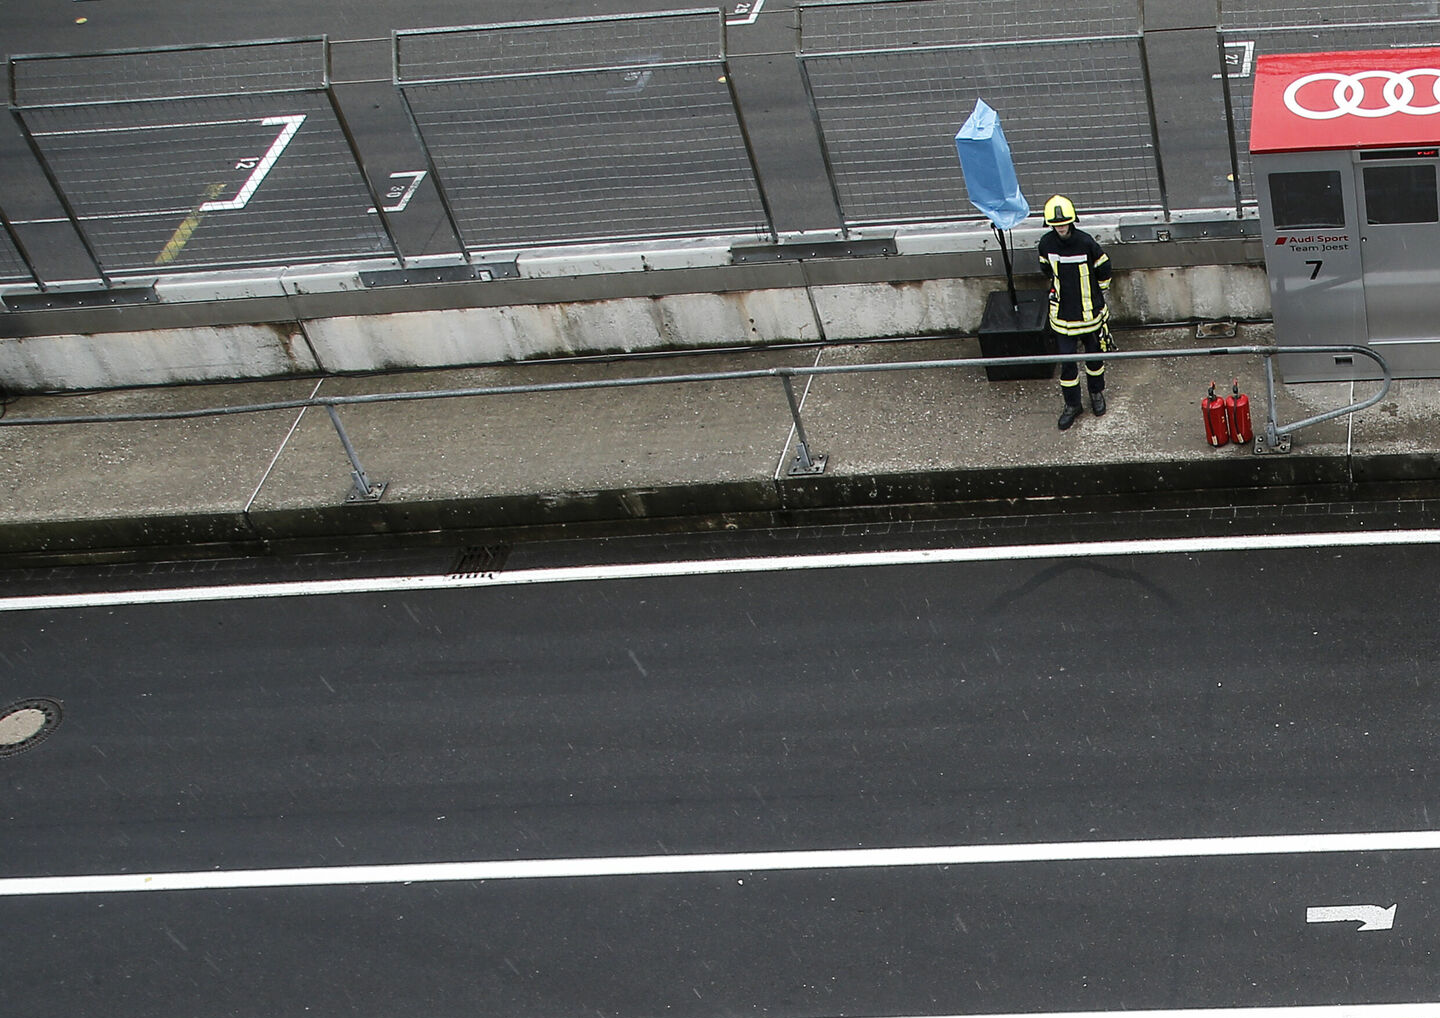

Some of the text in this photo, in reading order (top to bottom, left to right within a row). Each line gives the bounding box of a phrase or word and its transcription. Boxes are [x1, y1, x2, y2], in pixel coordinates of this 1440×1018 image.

[1225, 54, 1239, 66] 27
[235, 156, 260, 170] 12
[386, 185, 405, 199] 30
[1317, 234, 1349, 243] Sport
[1321, 243, 1349, 252] Joest
[1305, 260, 1323, 280] 7
